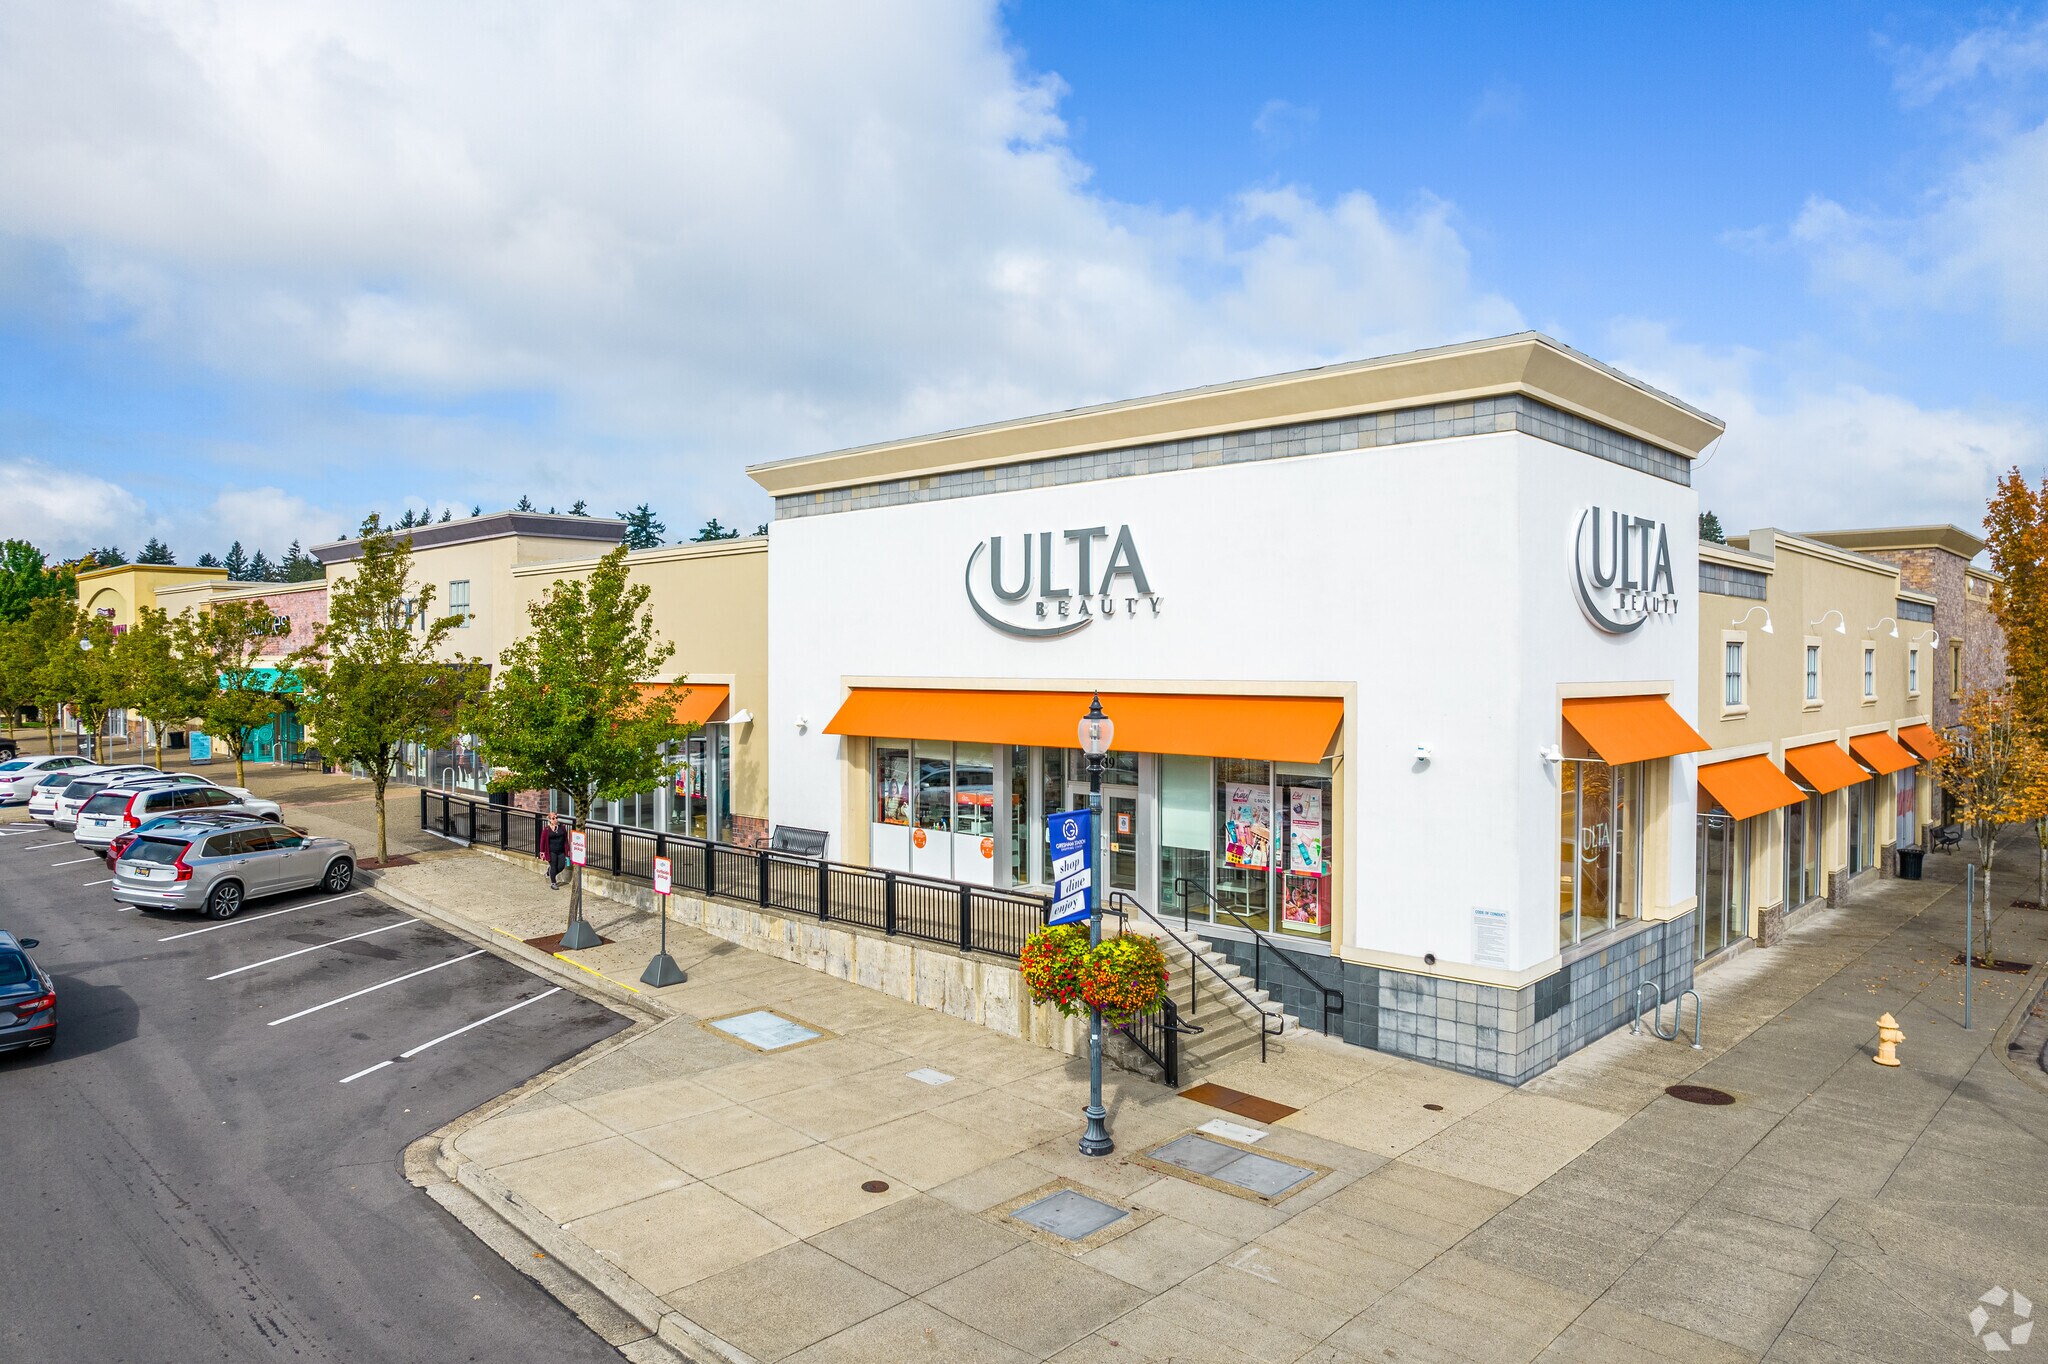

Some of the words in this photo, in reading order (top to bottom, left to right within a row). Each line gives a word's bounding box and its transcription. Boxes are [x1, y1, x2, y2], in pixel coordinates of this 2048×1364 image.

[1591, 505, 1675, 595] ULTA
[990, 524, 1152, 600] ULTA
[1035, 597, 1163, 616] BEAUTY
[1619, 593, 1679, 614] BEAUTY
[1583, 822, 1611, 850] ULTA
[1060, 858, 1079, 873] shop
[1065, 878, 1085, 893] dine
[1054, 899, 1077, 914] enjoy
